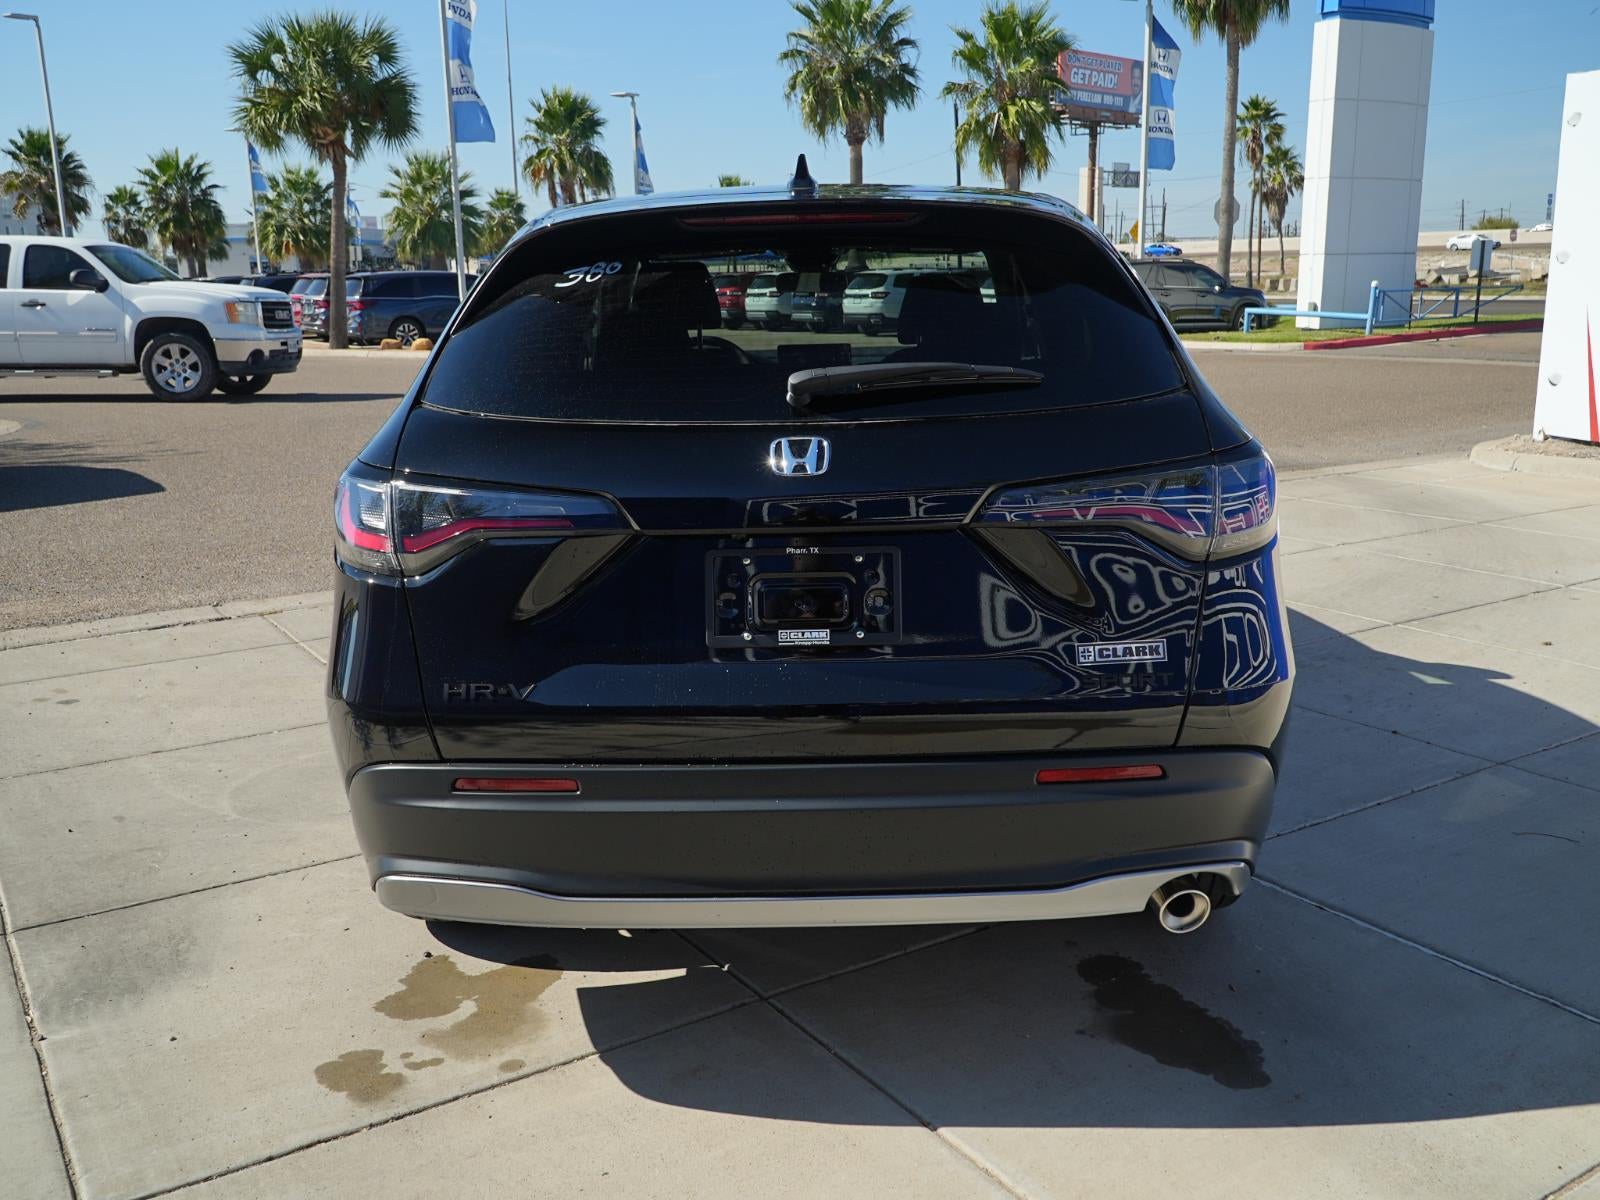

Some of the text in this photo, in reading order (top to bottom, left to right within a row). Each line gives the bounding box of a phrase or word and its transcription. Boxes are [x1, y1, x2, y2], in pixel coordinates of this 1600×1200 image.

[1071, 68, 1118, 88] GET PAID!
[790, 631, 828, 639] CLARK
[1097, 644, 1161, 659] CLARK
[1083, 673, 1175, 688] SPORT
[443, 683, 535, 701] HR-V
